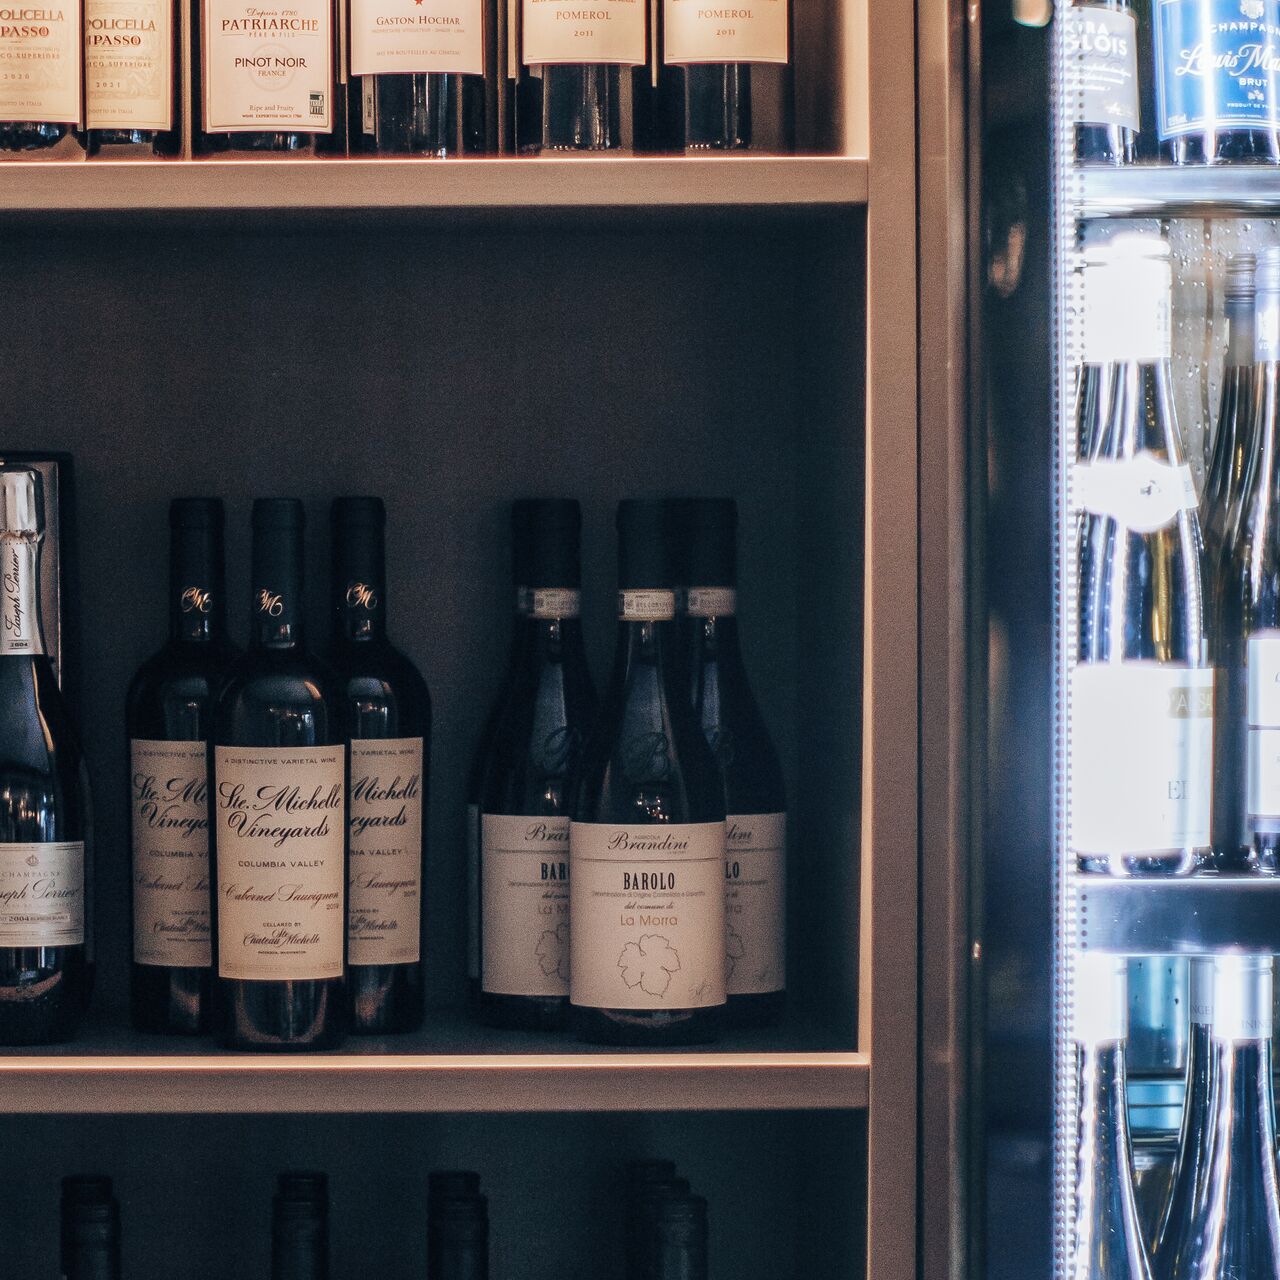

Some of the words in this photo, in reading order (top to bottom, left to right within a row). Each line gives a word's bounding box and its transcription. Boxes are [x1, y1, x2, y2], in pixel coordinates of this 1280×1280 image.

[246, 7, 277, 18] Depuis
[556, 11, 612, 20] POMEROL
[698, 10, 753, 19] POMEROL
[222, 18, 319, 32] PATRIARCHE
[376, 16, 414, 26] GASTON
[419, 15, 460, 25] HOCHAR
[234, 57, 271, 68] PINOT
[275, 57, 307, 68] NOIR
[1175, 42, 1238, 75] Louis
[1239, 77, 1269, 86] BRUT
[4, 548, 21, 593] Perrier
[5, 596, 24, 637] Joseph
[133, 774, 159, 801] Ste.
[219, 781, 250, 810] Ste.
[253, 783, 340, 814] Michelle
[228, 811, 329, 847] Vineyards
[607, 831, 690, 851] Brandini
[149, 850, 193, 858] COLUMBIA
[370, 848, 402, 856] VALLEY
[238, 860, 286, 868] COLUMBIA
[359, 872, 416, 897] Sauvignon
[623, 872, 675, 890] BAROLO
[32, 878, 80, 900] Perrier
[222, 884, 275, 902] Cabernet
[278, 883, 339, 909] Sauvignon
[624, 902, 635, 910] del
[620, 915, 634, 926] La
[639, 915, 677, 926] Morra
[281, 931, 320, 947] Michelle
